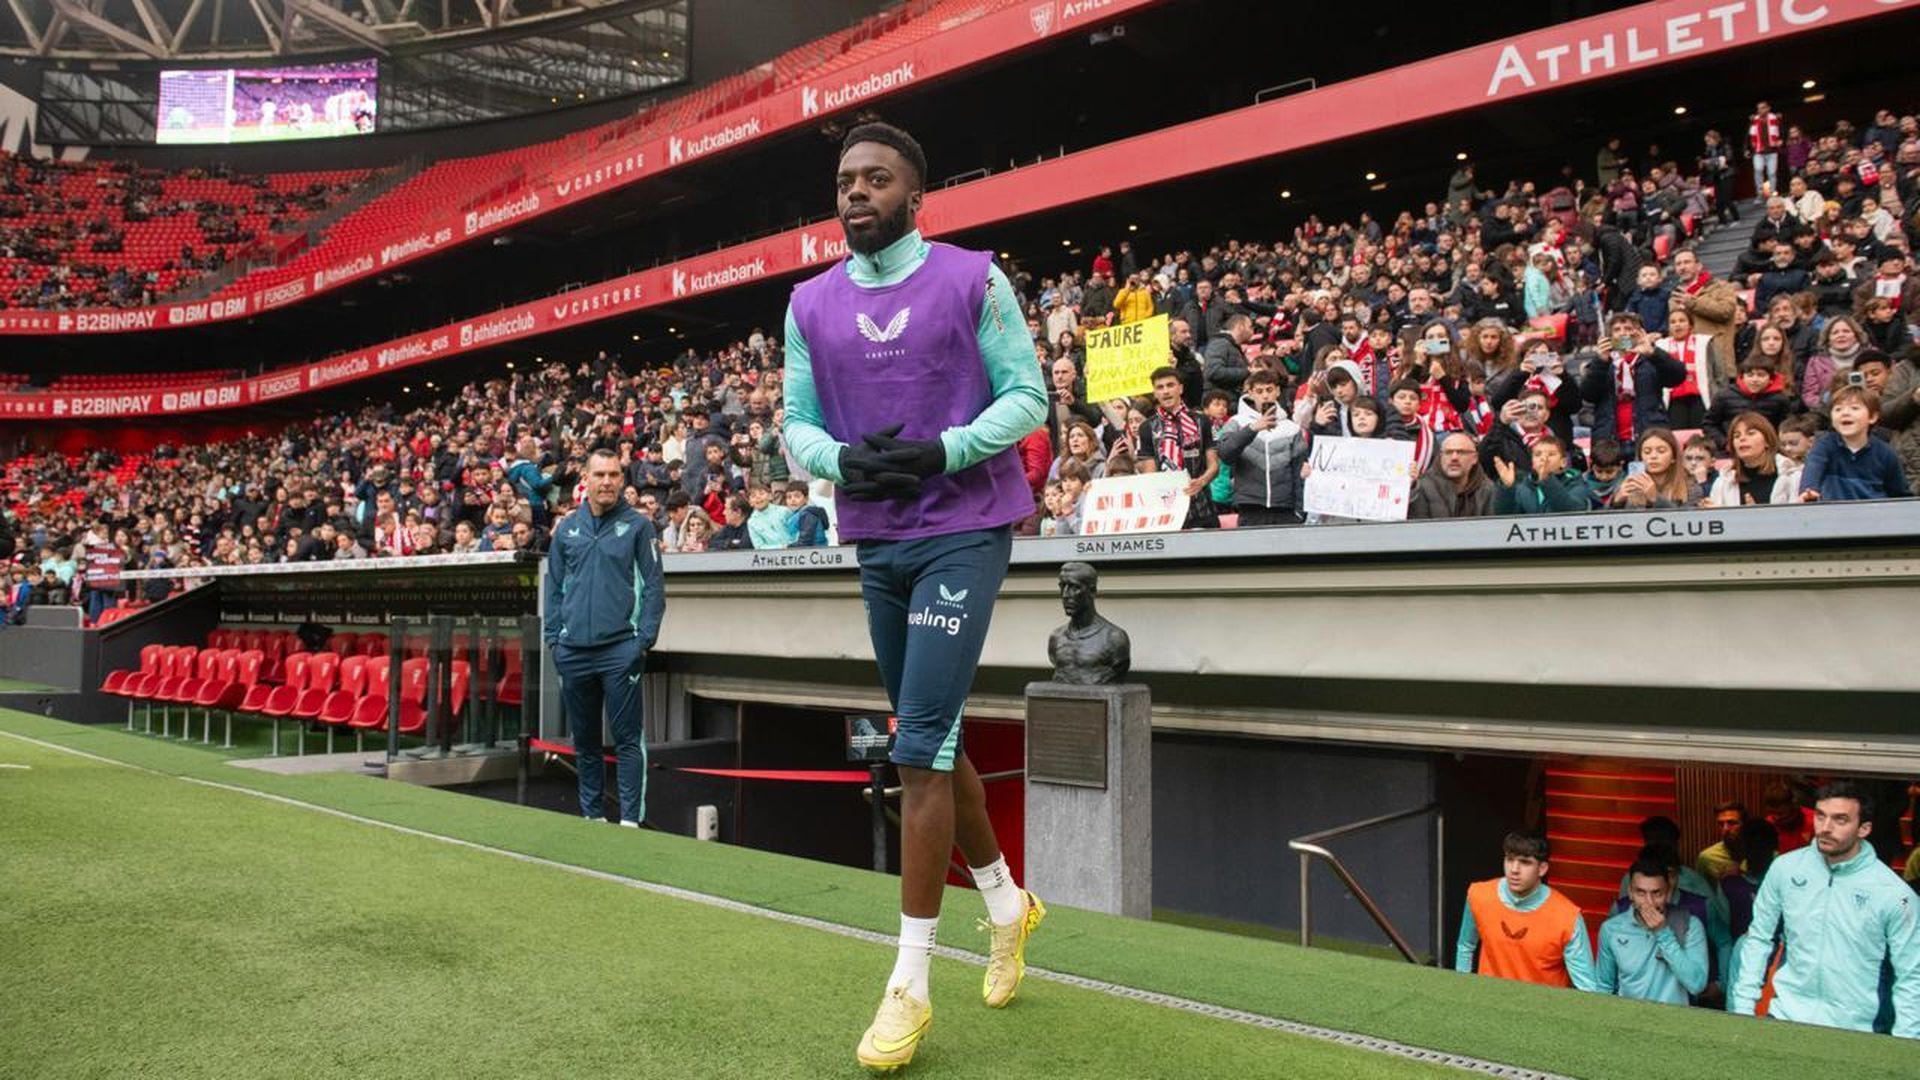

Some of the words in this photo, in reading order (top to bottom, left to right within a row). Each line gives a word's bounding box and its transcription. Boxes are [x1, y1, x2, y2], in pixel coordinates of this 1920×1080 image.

[1488, 0, 1829, 96] ATHLETIC
[824, 62, 914, 109] kutxabank
[687, 119, 761, 158] kutxabank
[575, 153, 644, 190] CASTORE
[690, 258, 765, 292] kutxabank
[185, 304, 208, 323] BM
[225, 297, 247, 316] BM
[572, 285, 642, 314] CASTORE
[76, 311, 156, 331] B2BINPAY
[1087, 324, 1143, 348] JAURE
[71, 395, 151, 415] B2BINPAY
[179, 391, 201, 409] BM
[219, 386, 240, 404] BM
[1506, 523, 1633, 542] ATHLETIC
[1646, 517, 1725, 537] CLUB
[1076, 542, 1105, 553] SAN
[1111, 538, 1165, 553] MAMES
[752, 554, 805, 566] ATHLETIC
[810, 551, 843, 565] CLUB
